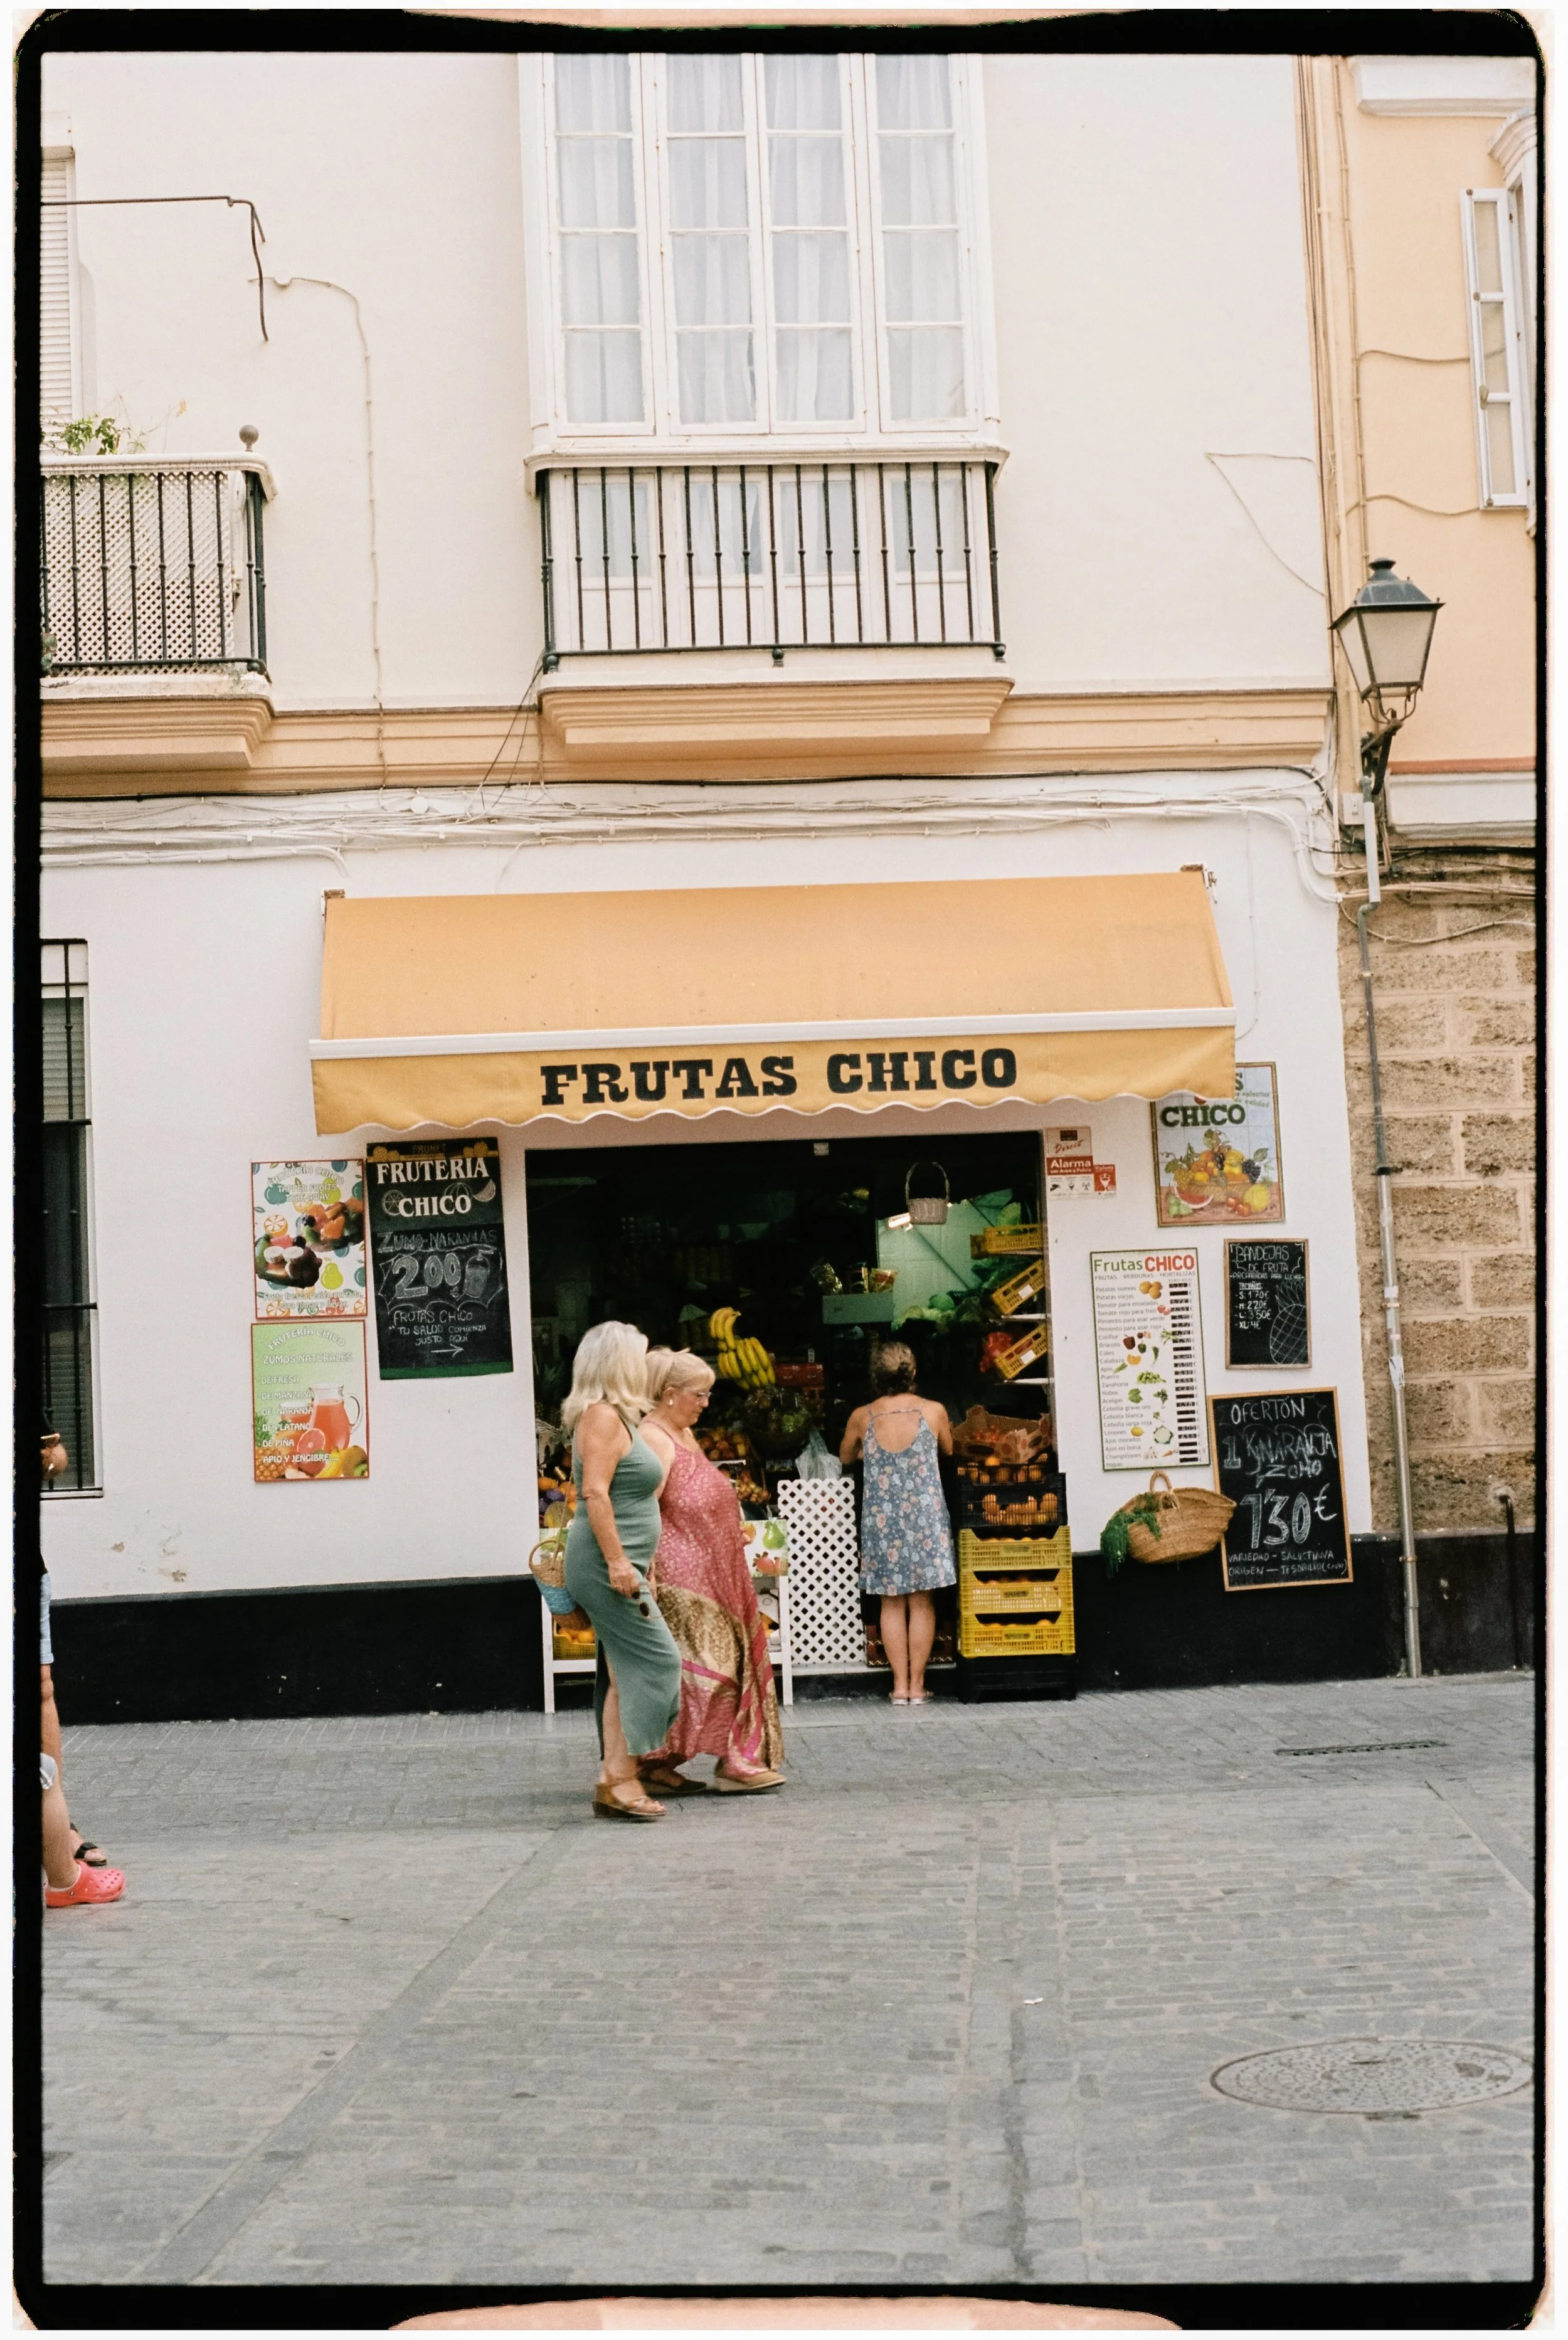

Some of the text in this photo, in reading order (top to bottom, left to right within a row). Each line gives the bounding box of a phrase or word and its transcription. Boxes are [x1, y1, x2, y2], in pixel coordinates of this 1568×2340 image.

[540, 1048, 1018, 1106] FRUTAS CHICO
[1159, 1104, 1246, 1128] CHICO
[1051, 1158, 1091, 1168] Alarma
[376, 1158, 489, 1185] FRUTERIA
[398, 1194, 472, 1218] CHICO
[1236, 1245, 1289, 1262] BANDEJAS
[1094, 1254, 1195, 1273] Frutas CHICO
[1248, 1263, 1288, 1273] DE FRUTA
[413, 1325, 443, 1335] SALUD
[268, 1326, 346, 1351] FRUTERÍA CHICO
[415, 1335, 442, 1346] JUSTO
[263, 1352, 352, 1365] ZUMOS NATURALES
[277, 1407, 313, 1416] NARANJA
[1231, 1396, 1305, 1424] OFERTÓN
[262, 1439, 273, 1448] DE
[1229, 1552, 1269, 1562] VARIEDAD
[1229, 1565, 1264, 1576] ORIGEN
